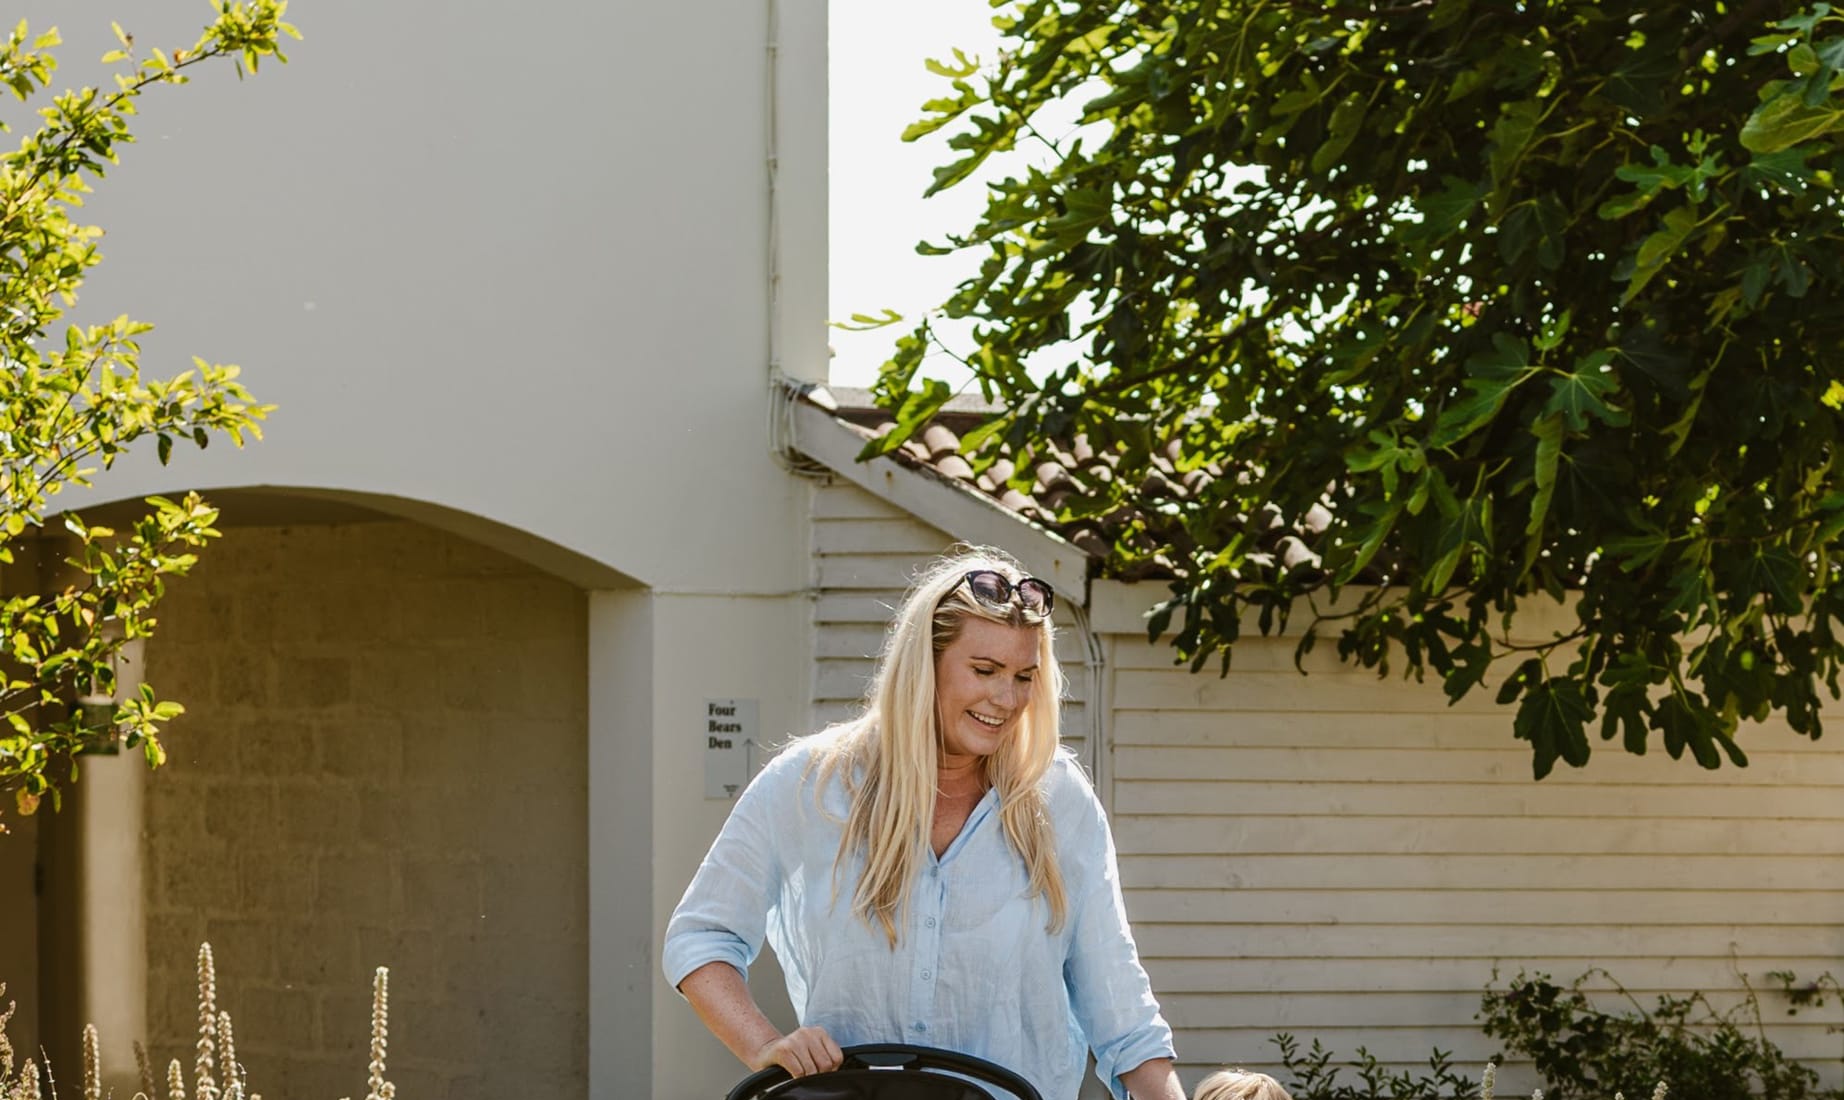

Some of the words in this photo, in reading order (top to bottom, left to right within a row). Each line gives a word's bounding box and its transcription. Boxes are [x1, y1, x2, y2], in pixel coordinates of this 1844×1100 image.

[708, 703, 736, 717] Four
[708, 720, 742, 733] Bears
[708, 736, 732, 749] Den
